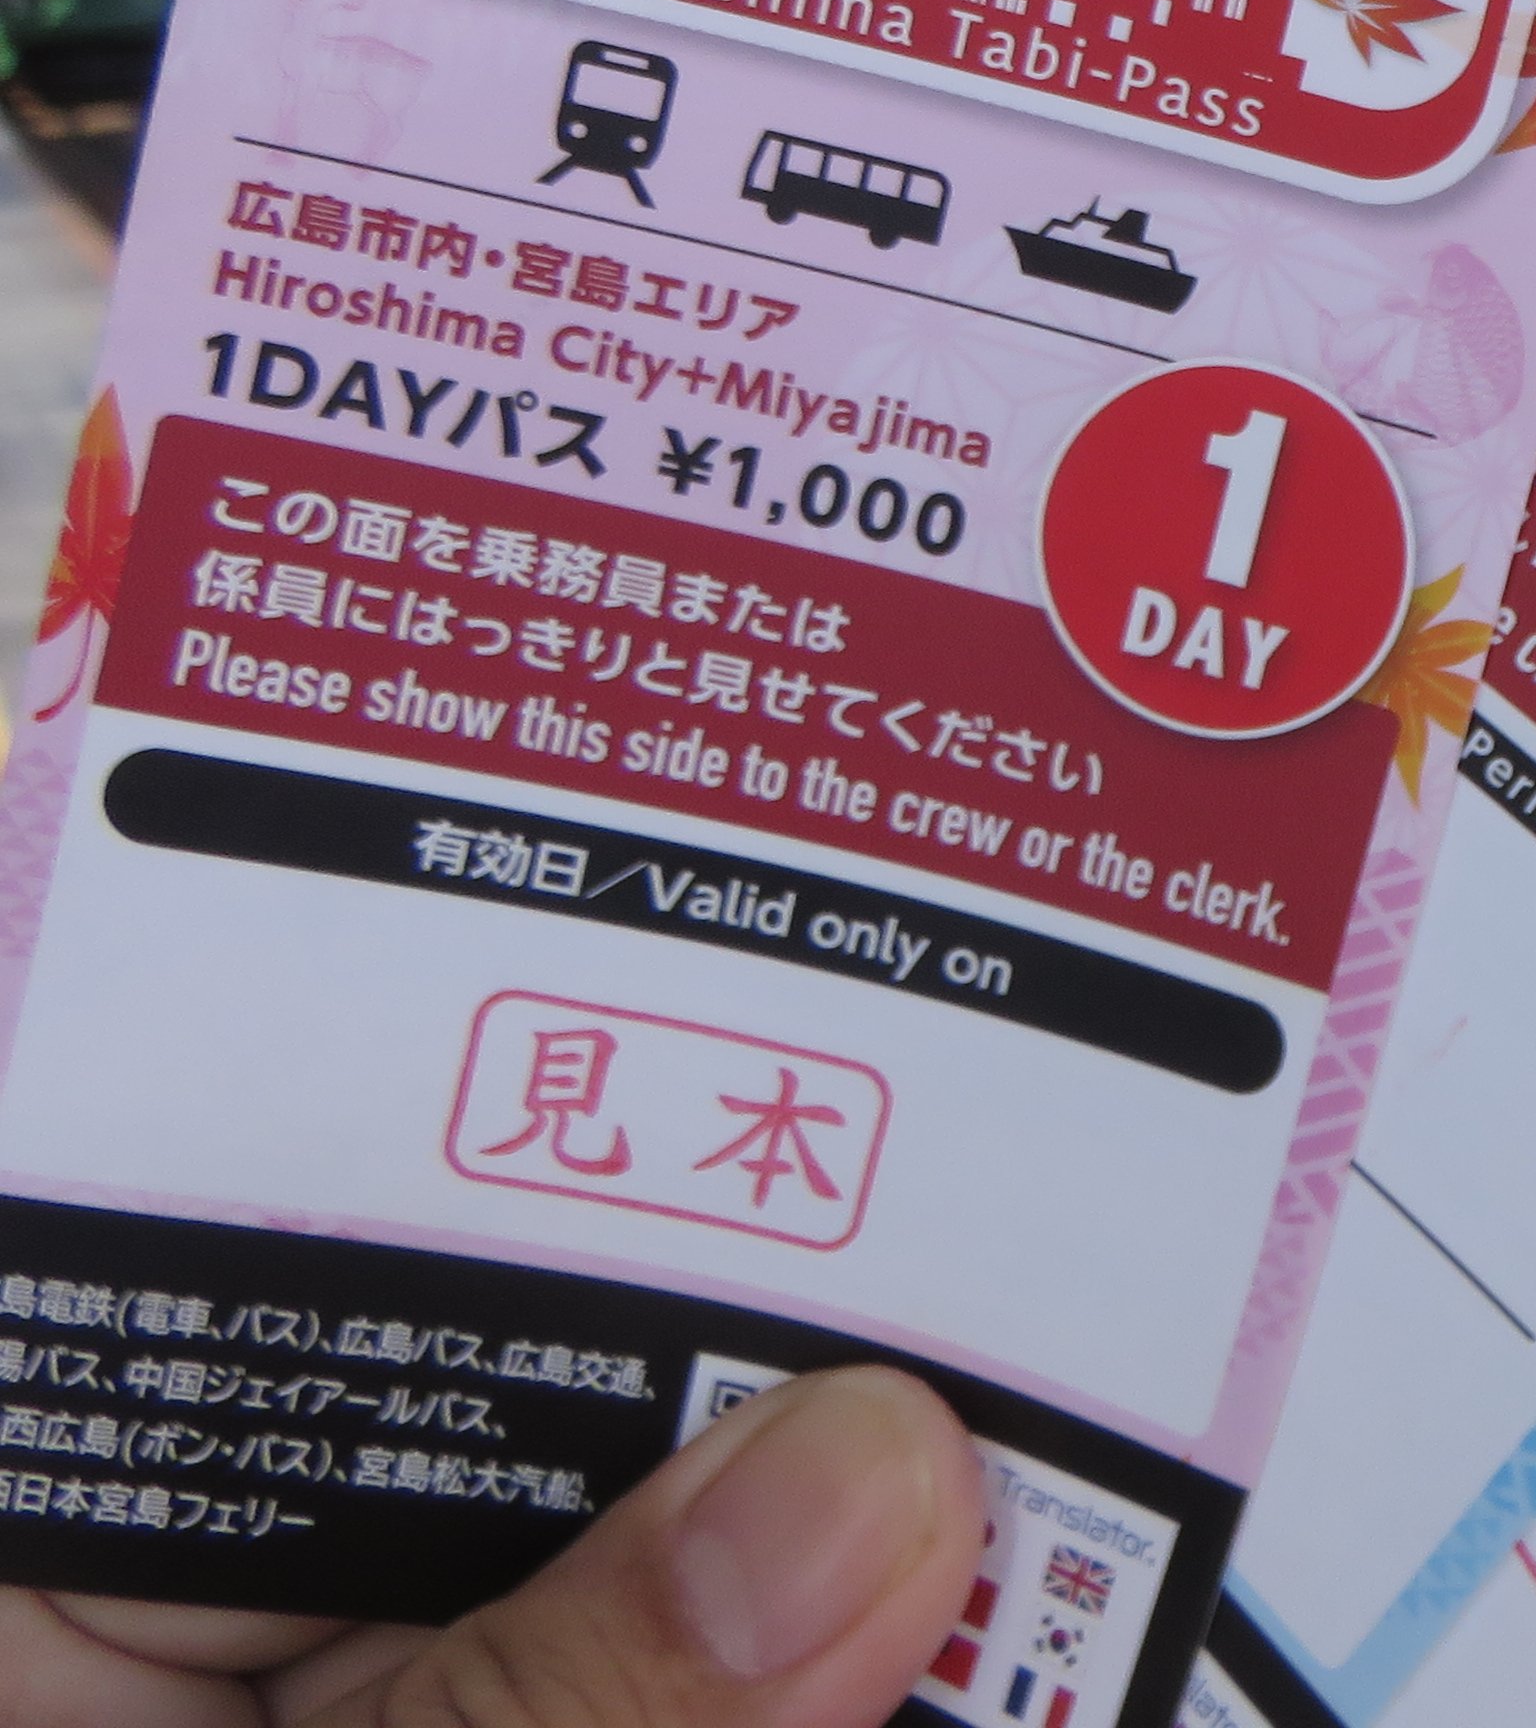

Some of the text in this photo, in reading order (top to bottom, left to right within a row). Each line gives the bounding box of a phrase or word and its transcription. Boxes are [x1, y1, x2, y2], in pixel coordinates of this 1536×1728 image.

[949, 9, 1264, 136] Tabi-Pass
[227, 181, 798, 341] 広島市内・宮島エリア
[205, 333, 966, 558] 1DAYパス ¥1,000
[213, 251, 992, 467] Hiroshima City+Miyajima
[213, 477, 851, 653] この面を乗務員または
[1205, 408, 1286, 588] 1
[194, 552, 1102, 794] 係員にはっきりと見せてください
[1122, 587, 1289, 690] DAY
[175, 630, 1291, 947] Please show this side to the crew or the clerk.
[809, 914, 930, 984] only
[944, 946, 1011, 996] on
[478, 1029, 845, 1209] 見本
